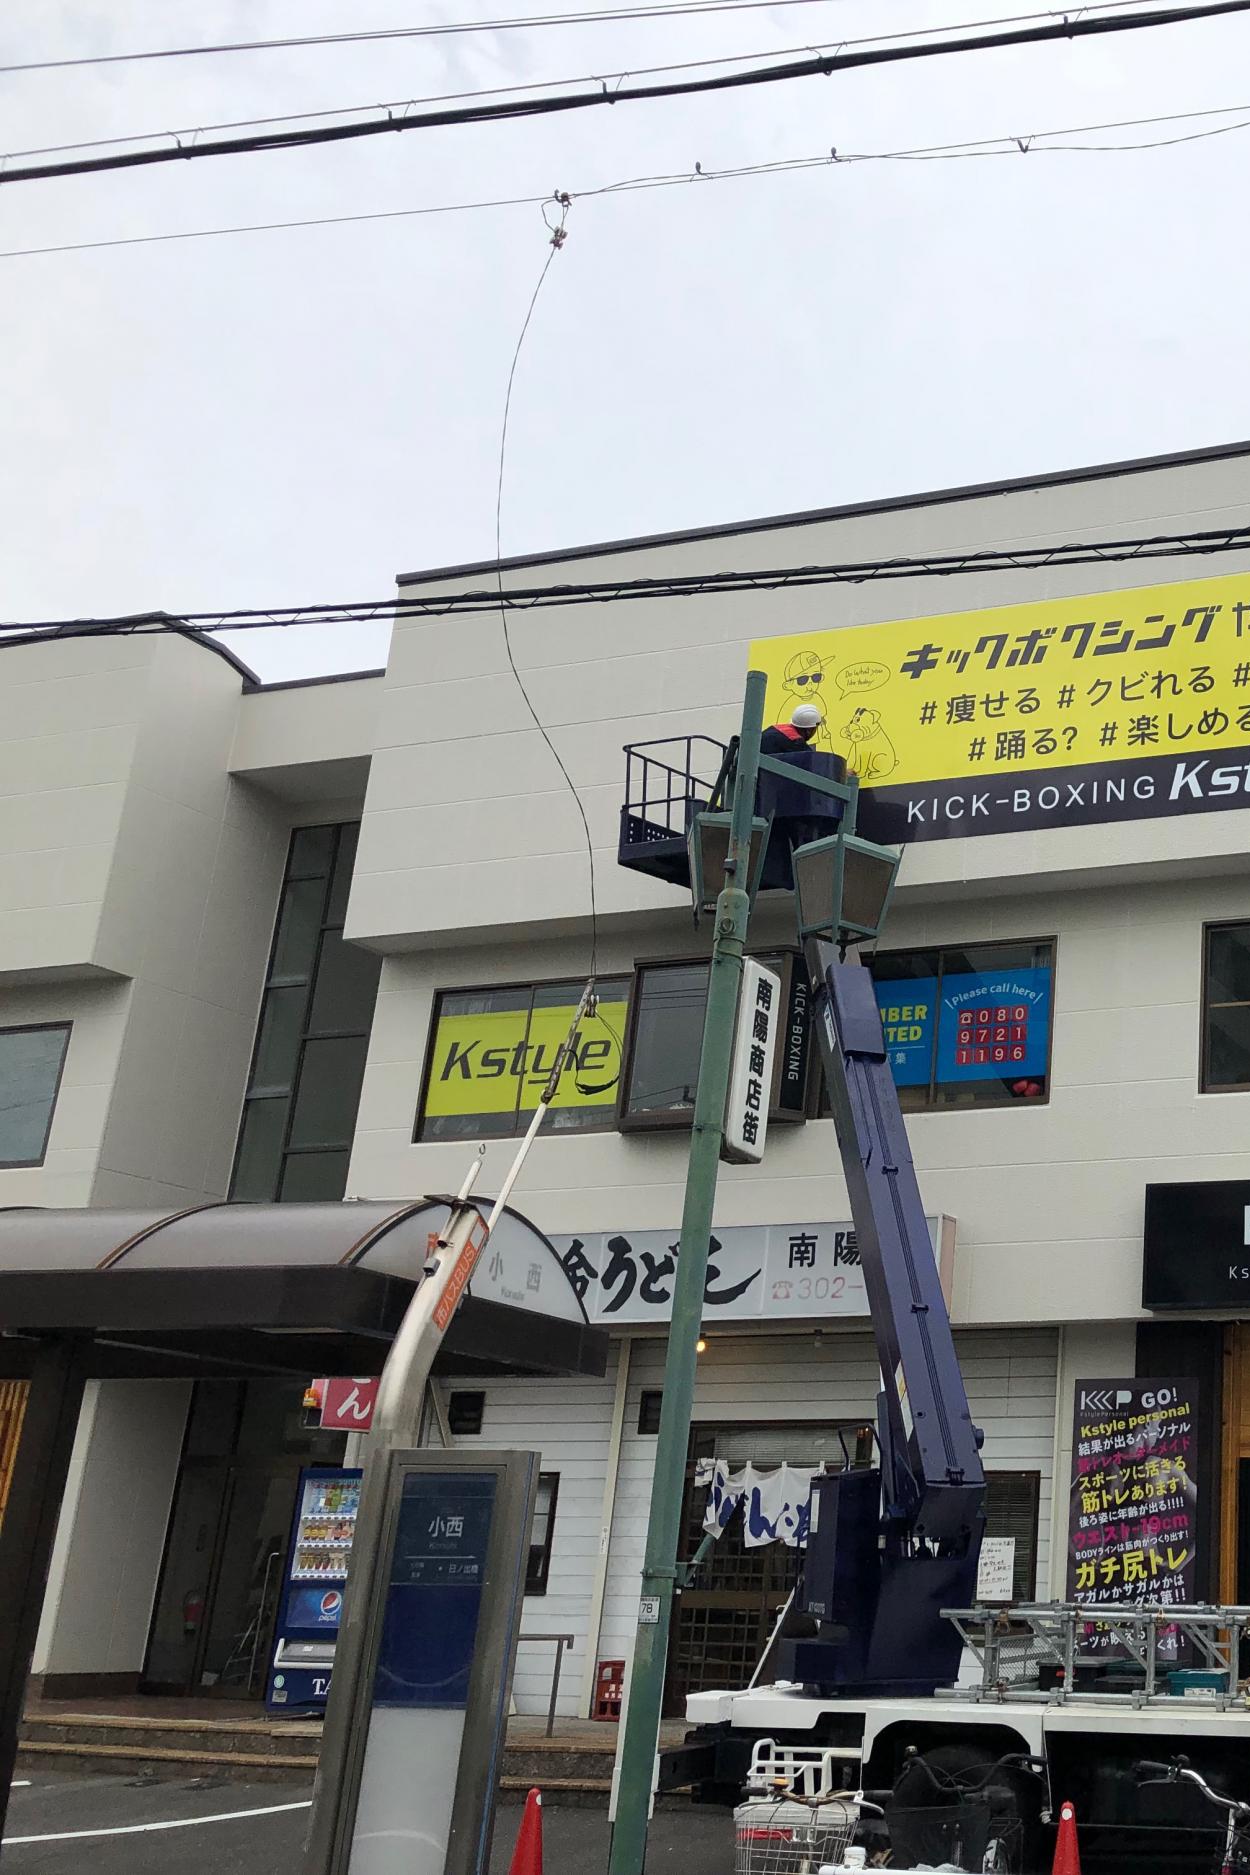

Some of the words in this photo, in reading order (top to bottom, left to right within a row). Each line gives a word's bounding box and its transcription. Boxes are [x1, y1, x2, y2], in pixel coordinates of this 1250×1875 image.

[907, 775, 1156, 823] KICK-BOXING
[952, 986, 987, 1006] Please
[990, 983, 1009, 993] call
[1011, 984, 1036, 999] here
[979, 1008, 1025, 1022] 080
[788, 983, 807, 1081] KICK-BOXING
[884, 1026, 922, 1043] TED
[961, 1027, 1021, 1043] 9721
[440, 1032, 611, 1084] Kstyle
[742, 976, 773, 1146] 南陽商店街
[961, 1047, 1022, 1063] 1196
[1141, 1387, 1177, 1408] GO!
[1081, 1420, 1125, 1438] Kstyle
[1129, 1402, 1190, 1429] personal
[428, 1516, 464, 1537] 小西
[1075, 1547, 1187, 1589] ガチ尻トレ
[641, 1603, 653, 1613] 78
